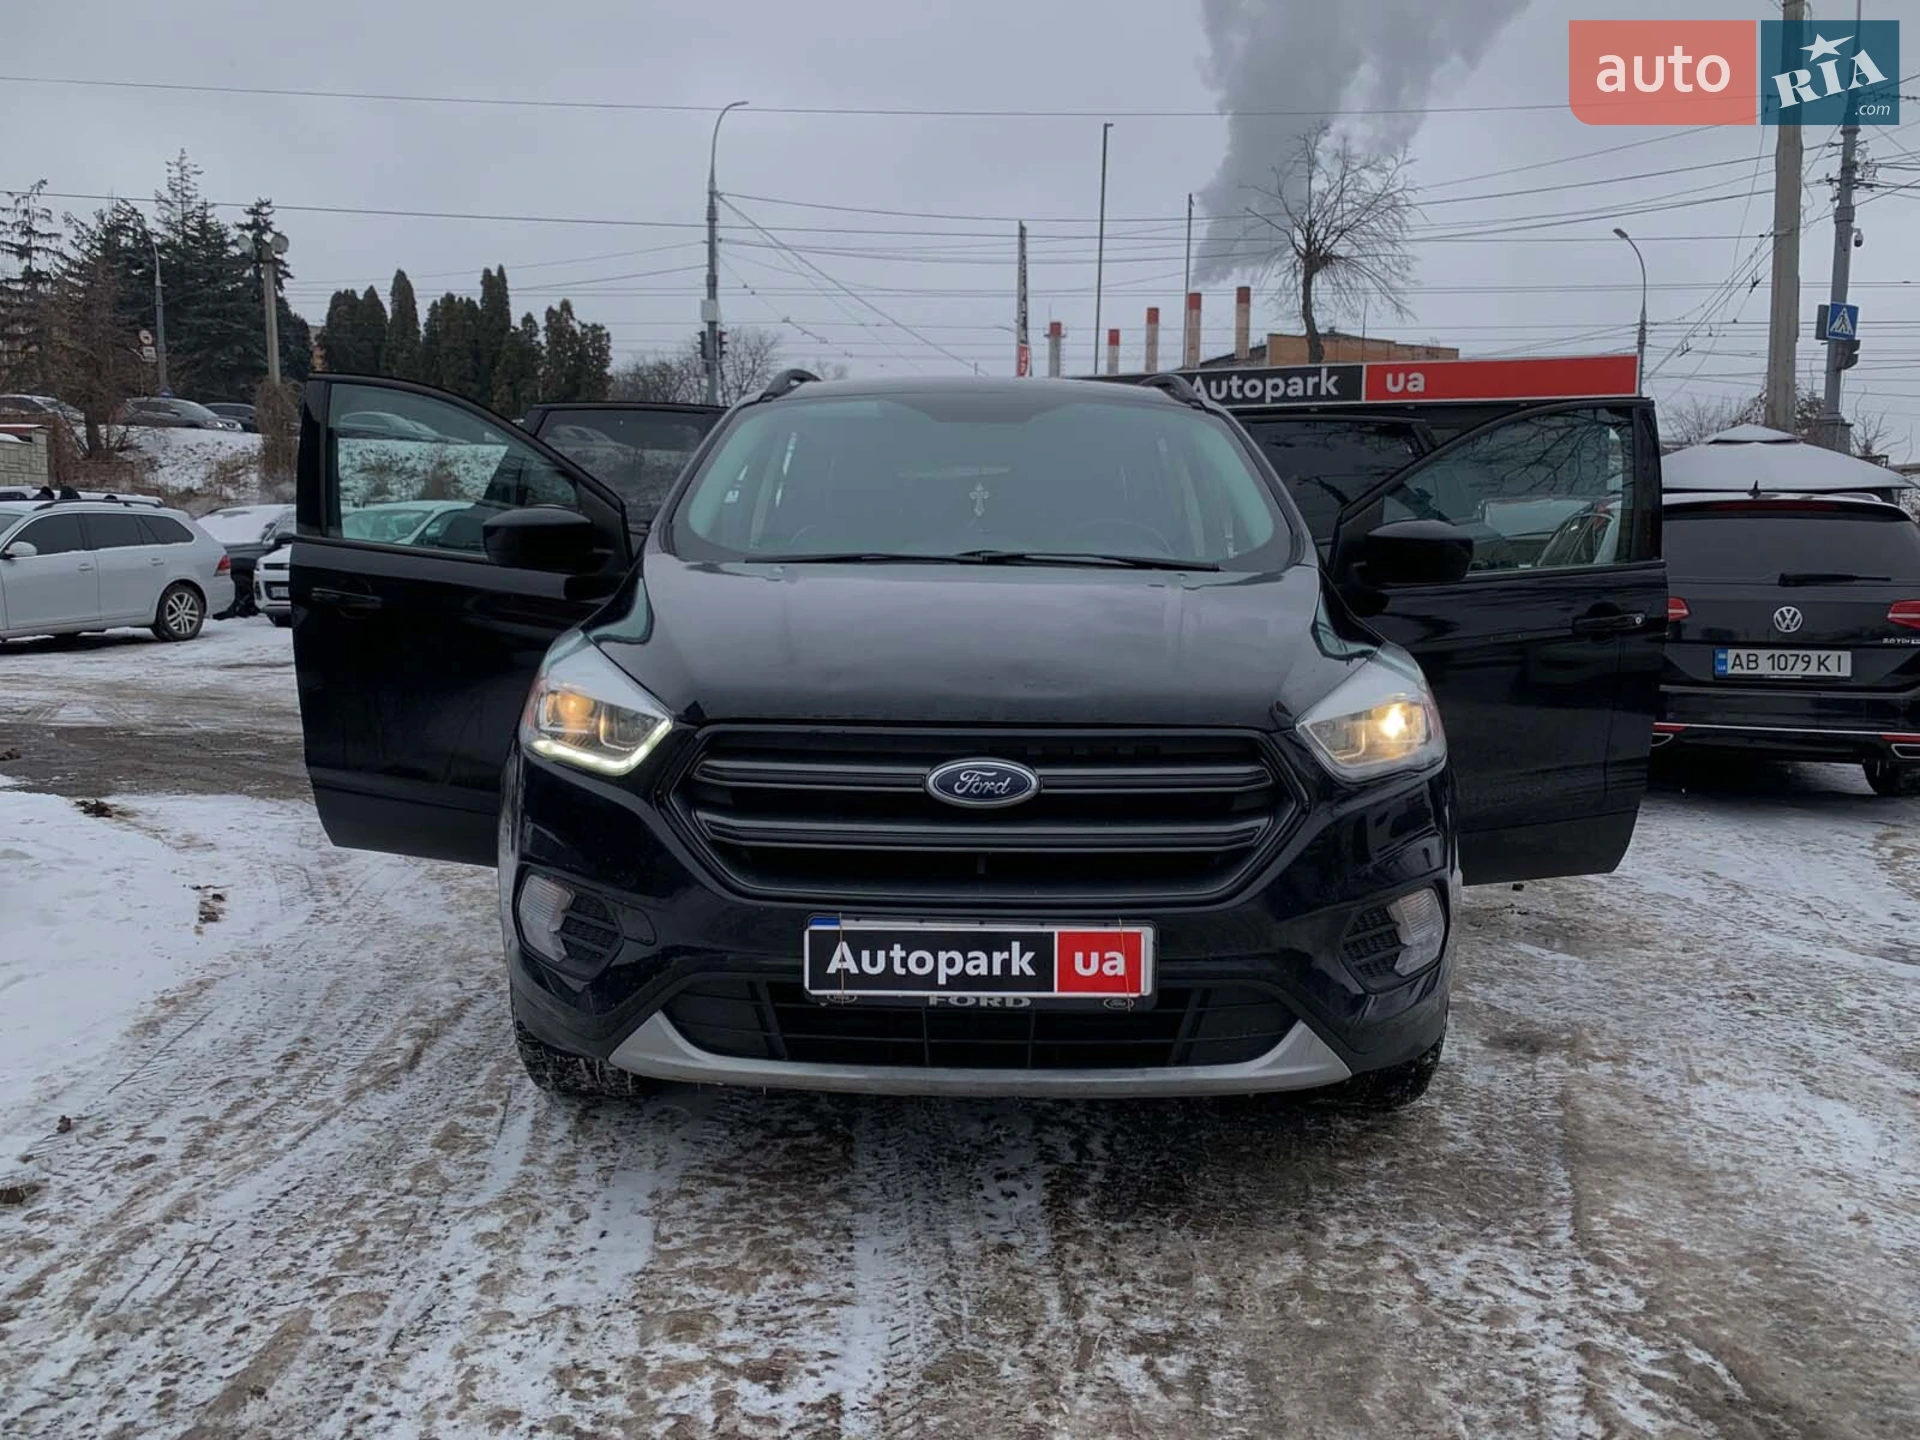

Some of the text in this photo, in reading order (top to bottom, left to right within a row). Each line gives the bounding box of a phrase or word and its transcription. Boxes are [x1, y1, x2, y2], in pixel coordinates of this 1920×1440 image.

[1192, 367, 1426, 403] Autopark ua
[1731, 652, 1842, 673] AB 1079 KI
[954, 769, 1012, 794] Ford
[826, 940, 1125, 985] Autopark ua
[928, 996, 1031, 1008] FORD
